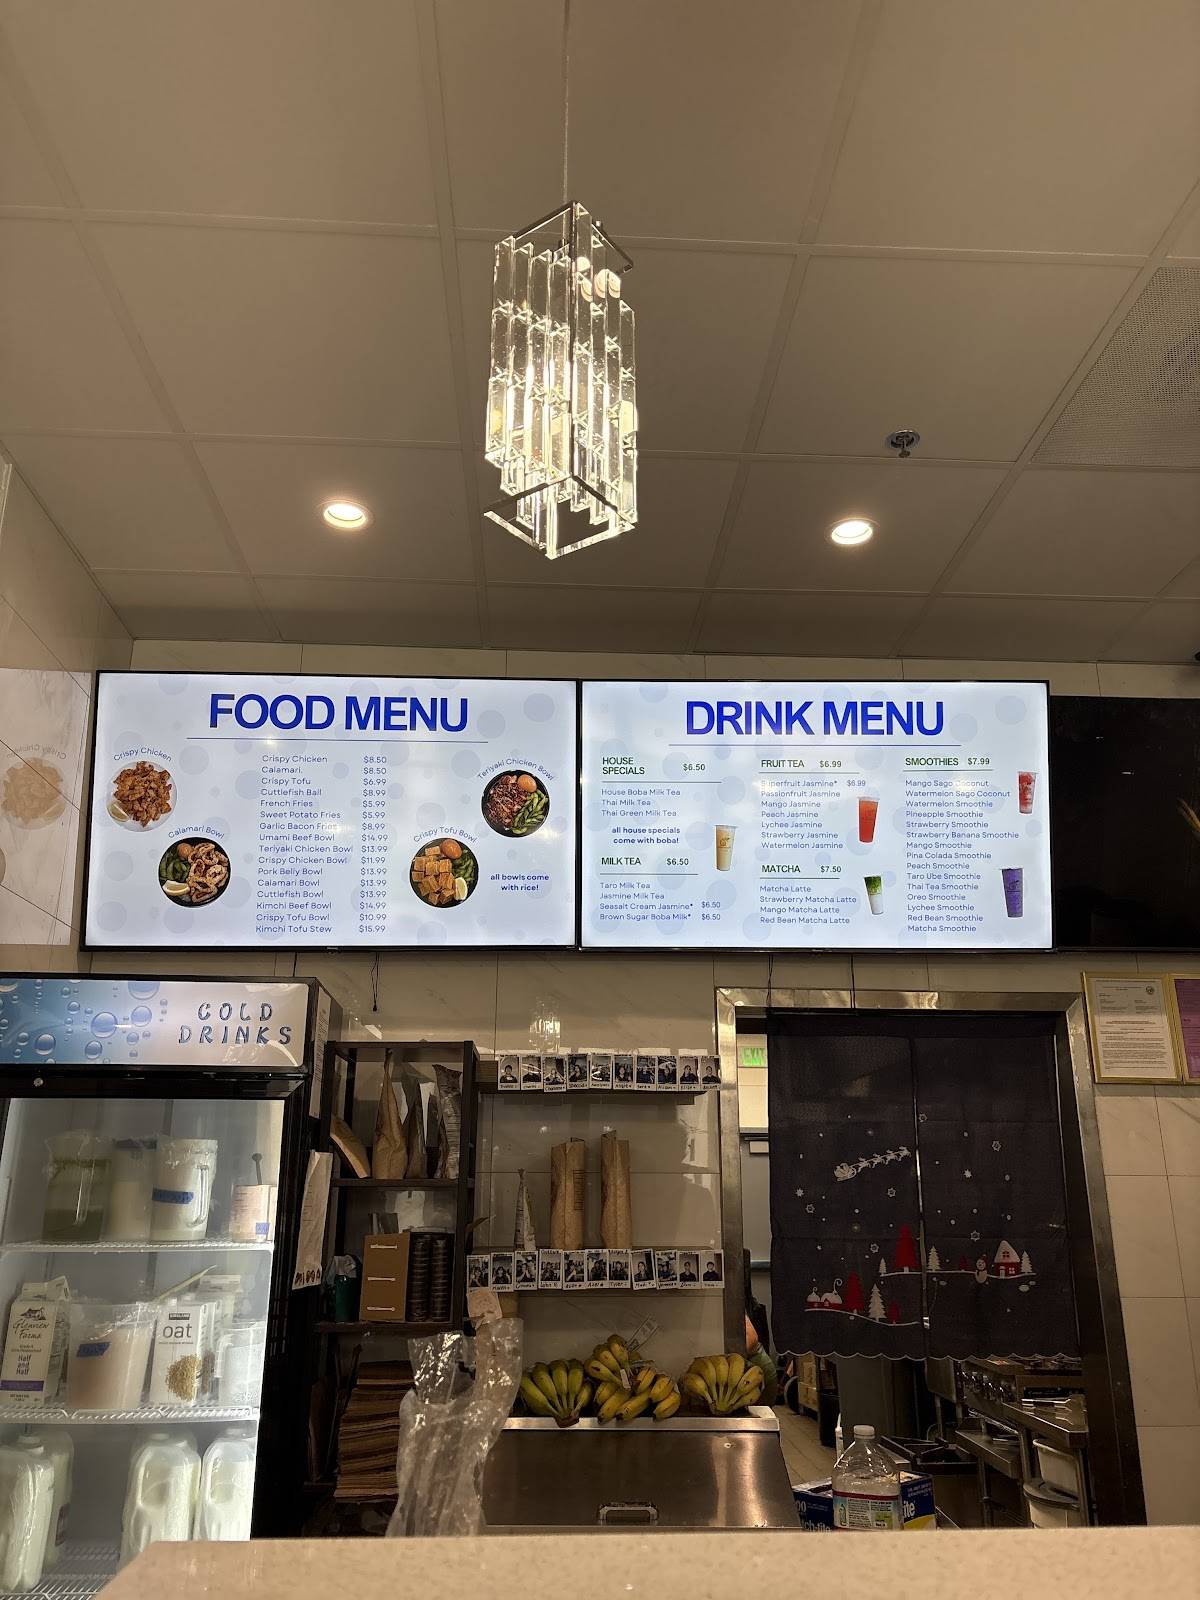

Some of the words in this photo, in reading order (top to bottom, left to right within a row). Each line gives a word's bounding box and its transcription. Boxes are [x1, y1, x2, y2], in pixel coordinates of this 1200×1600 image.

[210, 694, 335, 730] FOOD
[345, 696, 468, 732] MENU
[686, 701, 815, 735] DRINK
[823, 701, 944, 736] MENU
[113, 747, 139, 761] Crispy
[140, 747, 172, 762] Chicken
[262, 755, 290, 763] Crispy
[363, 756, 387, 764] $8.50
[478, 760, 505, 779] Teriyaki
[506, 758, 537, 768] Chicken
[537, 765, 555, 781] Bowl
[261, 778, 289, 786] Crispy
[761, 780, 800, 788] Sperfruit
[362, 811, 385, 819] $5.99
[906, 821, 949, 830] Strawberry
[168, 826, 204, 839] Calamari
[206, 826, 224, 839] Bowl
[413, 828, 438, 842] Crispy
[439, 827, 458, 835] Tofu
[458, 830, 478, 843] Bowl
[648, 827, 680, 835] specials
[761, 832, 804, 840] Strawberry
[907, 832, 950, 840] Strawberry
[259, 846, 293, 854] Teriyaki
[258, 857, 286, 865] Crispy
[361, 857, 385, 865] $11.99
[280, 868, 300, 877] Belly
[256, 914, 285, 922] Crispy
[627, 914, 649, 922] Sugar
[198, 1002, 274, 1022] COLD
[178, 1025, 292, 1046] DRINKS
[743, 1048, 765, 1065] EXIT
[162, 1324, 192, 1338] oat
[18, 1354, 31, 1362] Half
[16, 1368, 30, 1376] Half
